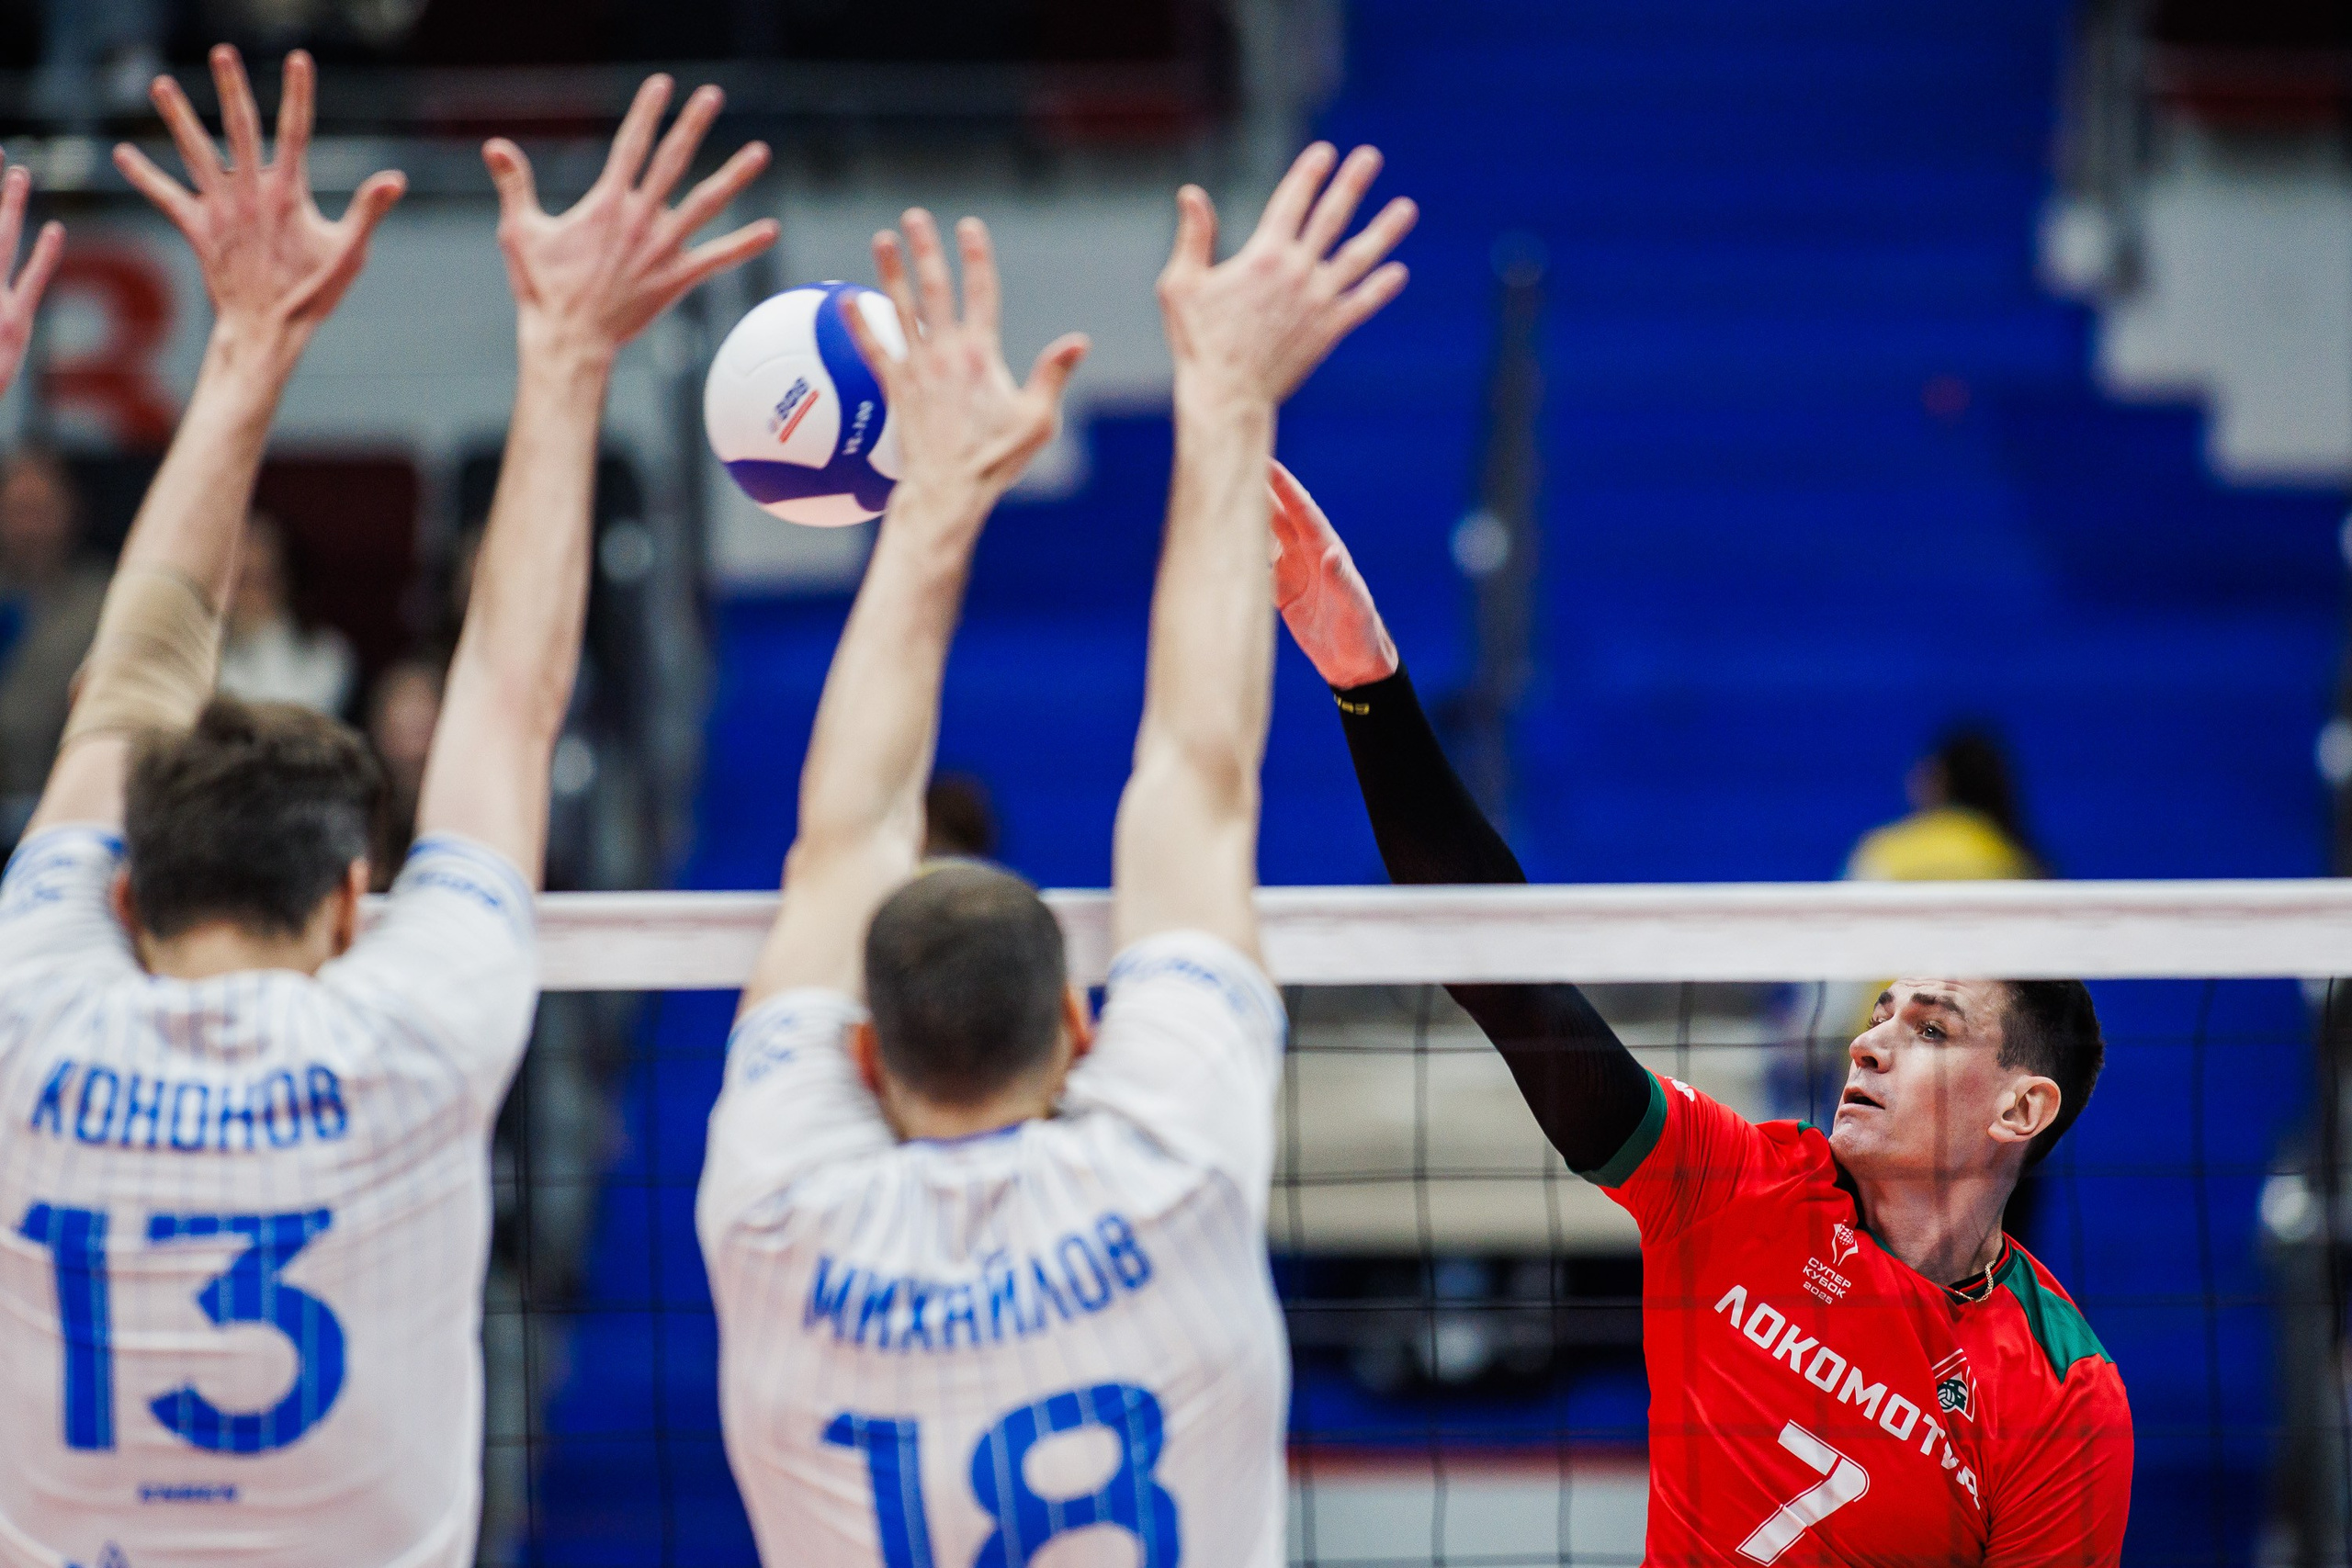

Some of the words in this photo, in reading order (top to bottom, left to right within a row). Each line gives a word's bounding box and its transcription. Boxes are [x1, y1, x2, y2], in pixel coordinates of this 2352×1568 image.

[30, 1058, 348, 1153] КОНОНОВ
[20, 1203, 347, 1457] 13
[801, 1212, 1154, 1353] МИХАЙЛОВ
[1803, 1265, 1847, 1299] КУБОК
[1803, 1280, 1834, 1305] 2025
[1807, 1257, 1852, 1288] СУПЕР
[822, 1382, 1180, 1568] 18
[1735, 1419, 1870, 1567] 7
